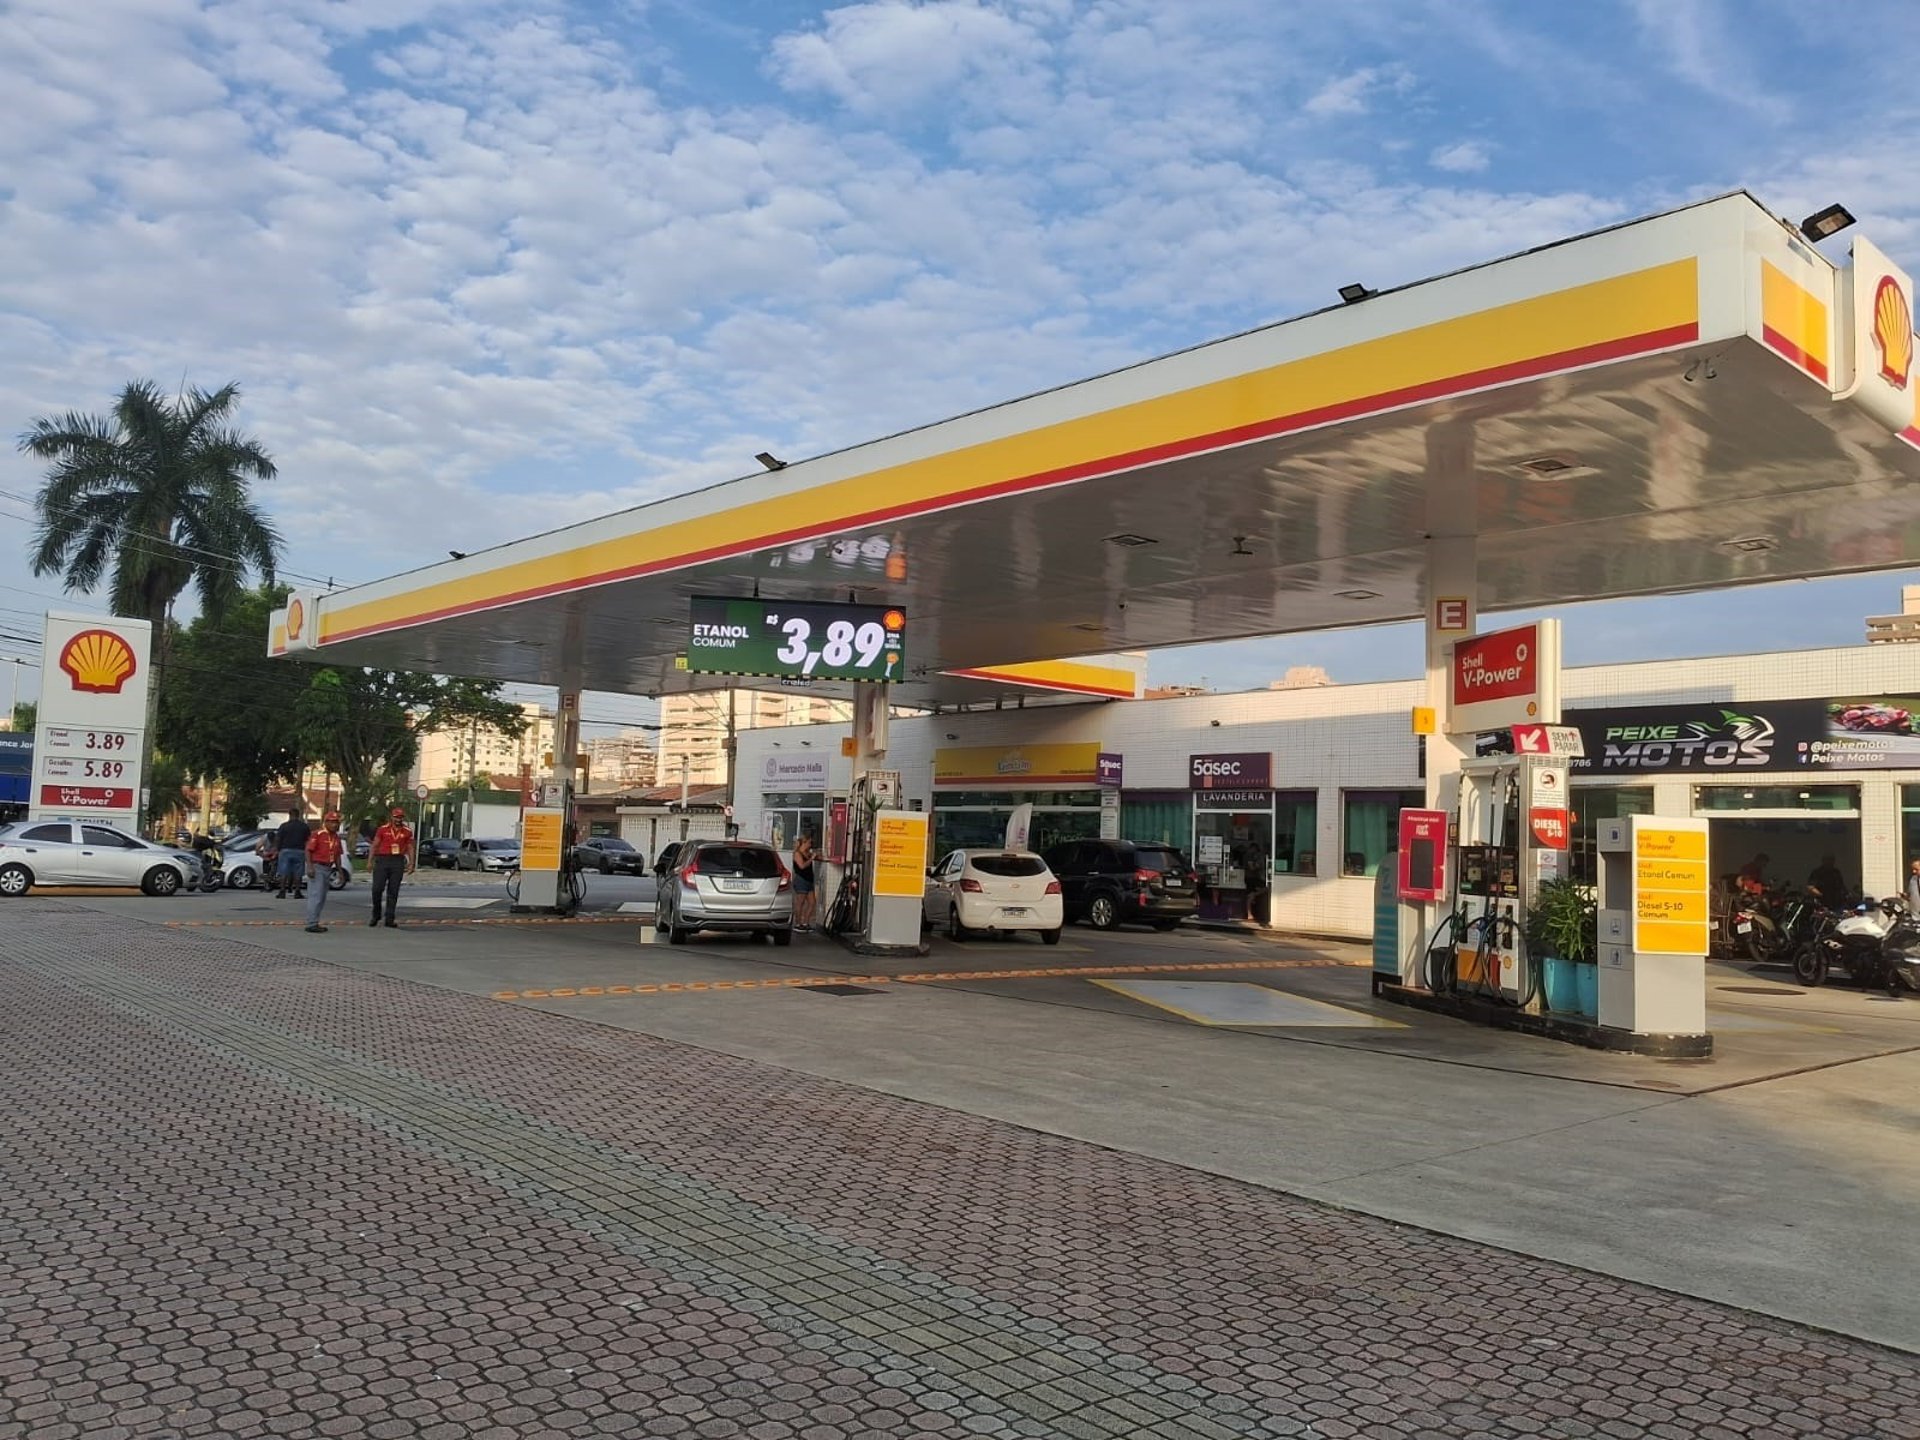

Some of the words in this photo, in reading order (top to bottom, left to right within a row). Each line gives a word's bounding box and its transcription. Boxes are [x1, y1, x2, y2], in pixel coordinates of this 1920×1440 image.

[1441, 602, 1462, 628] E
[693, 624, 750, 638] ETANOL
[692, 637, 736, 648] COMUM
[777, 618, 886, 674] 3,89
[1462, 653, 1483, 669] Shell
[1463, 666, 1522, 688] V-Power
[1606, 725, 1679, 740] PEIXE
[86, 733, 124, 750] 3.89
[1603, 739, 1774, 767] MOTOS
[1811, 754, 1844, 763] Peixe
[1847, 753, 1886, 762] Motos
[84, 761, 123, 778] 5.89
[61, 795, 110, 805] V-Power
[1203, 792, 1265, 802] LAVANDERIA
[1534, 819, 1562, 829] DIESEL
[1637, 842, 1672, 850] V-Power
[1638, 871, 1664, 879] Etanol
[1665, 871, 1695, 879] Comum
[1638, 901, 1662, 910] Diesel
[1664, 902, 1683, 911] S-10
[1638, 911, 1668, 919] Comum
